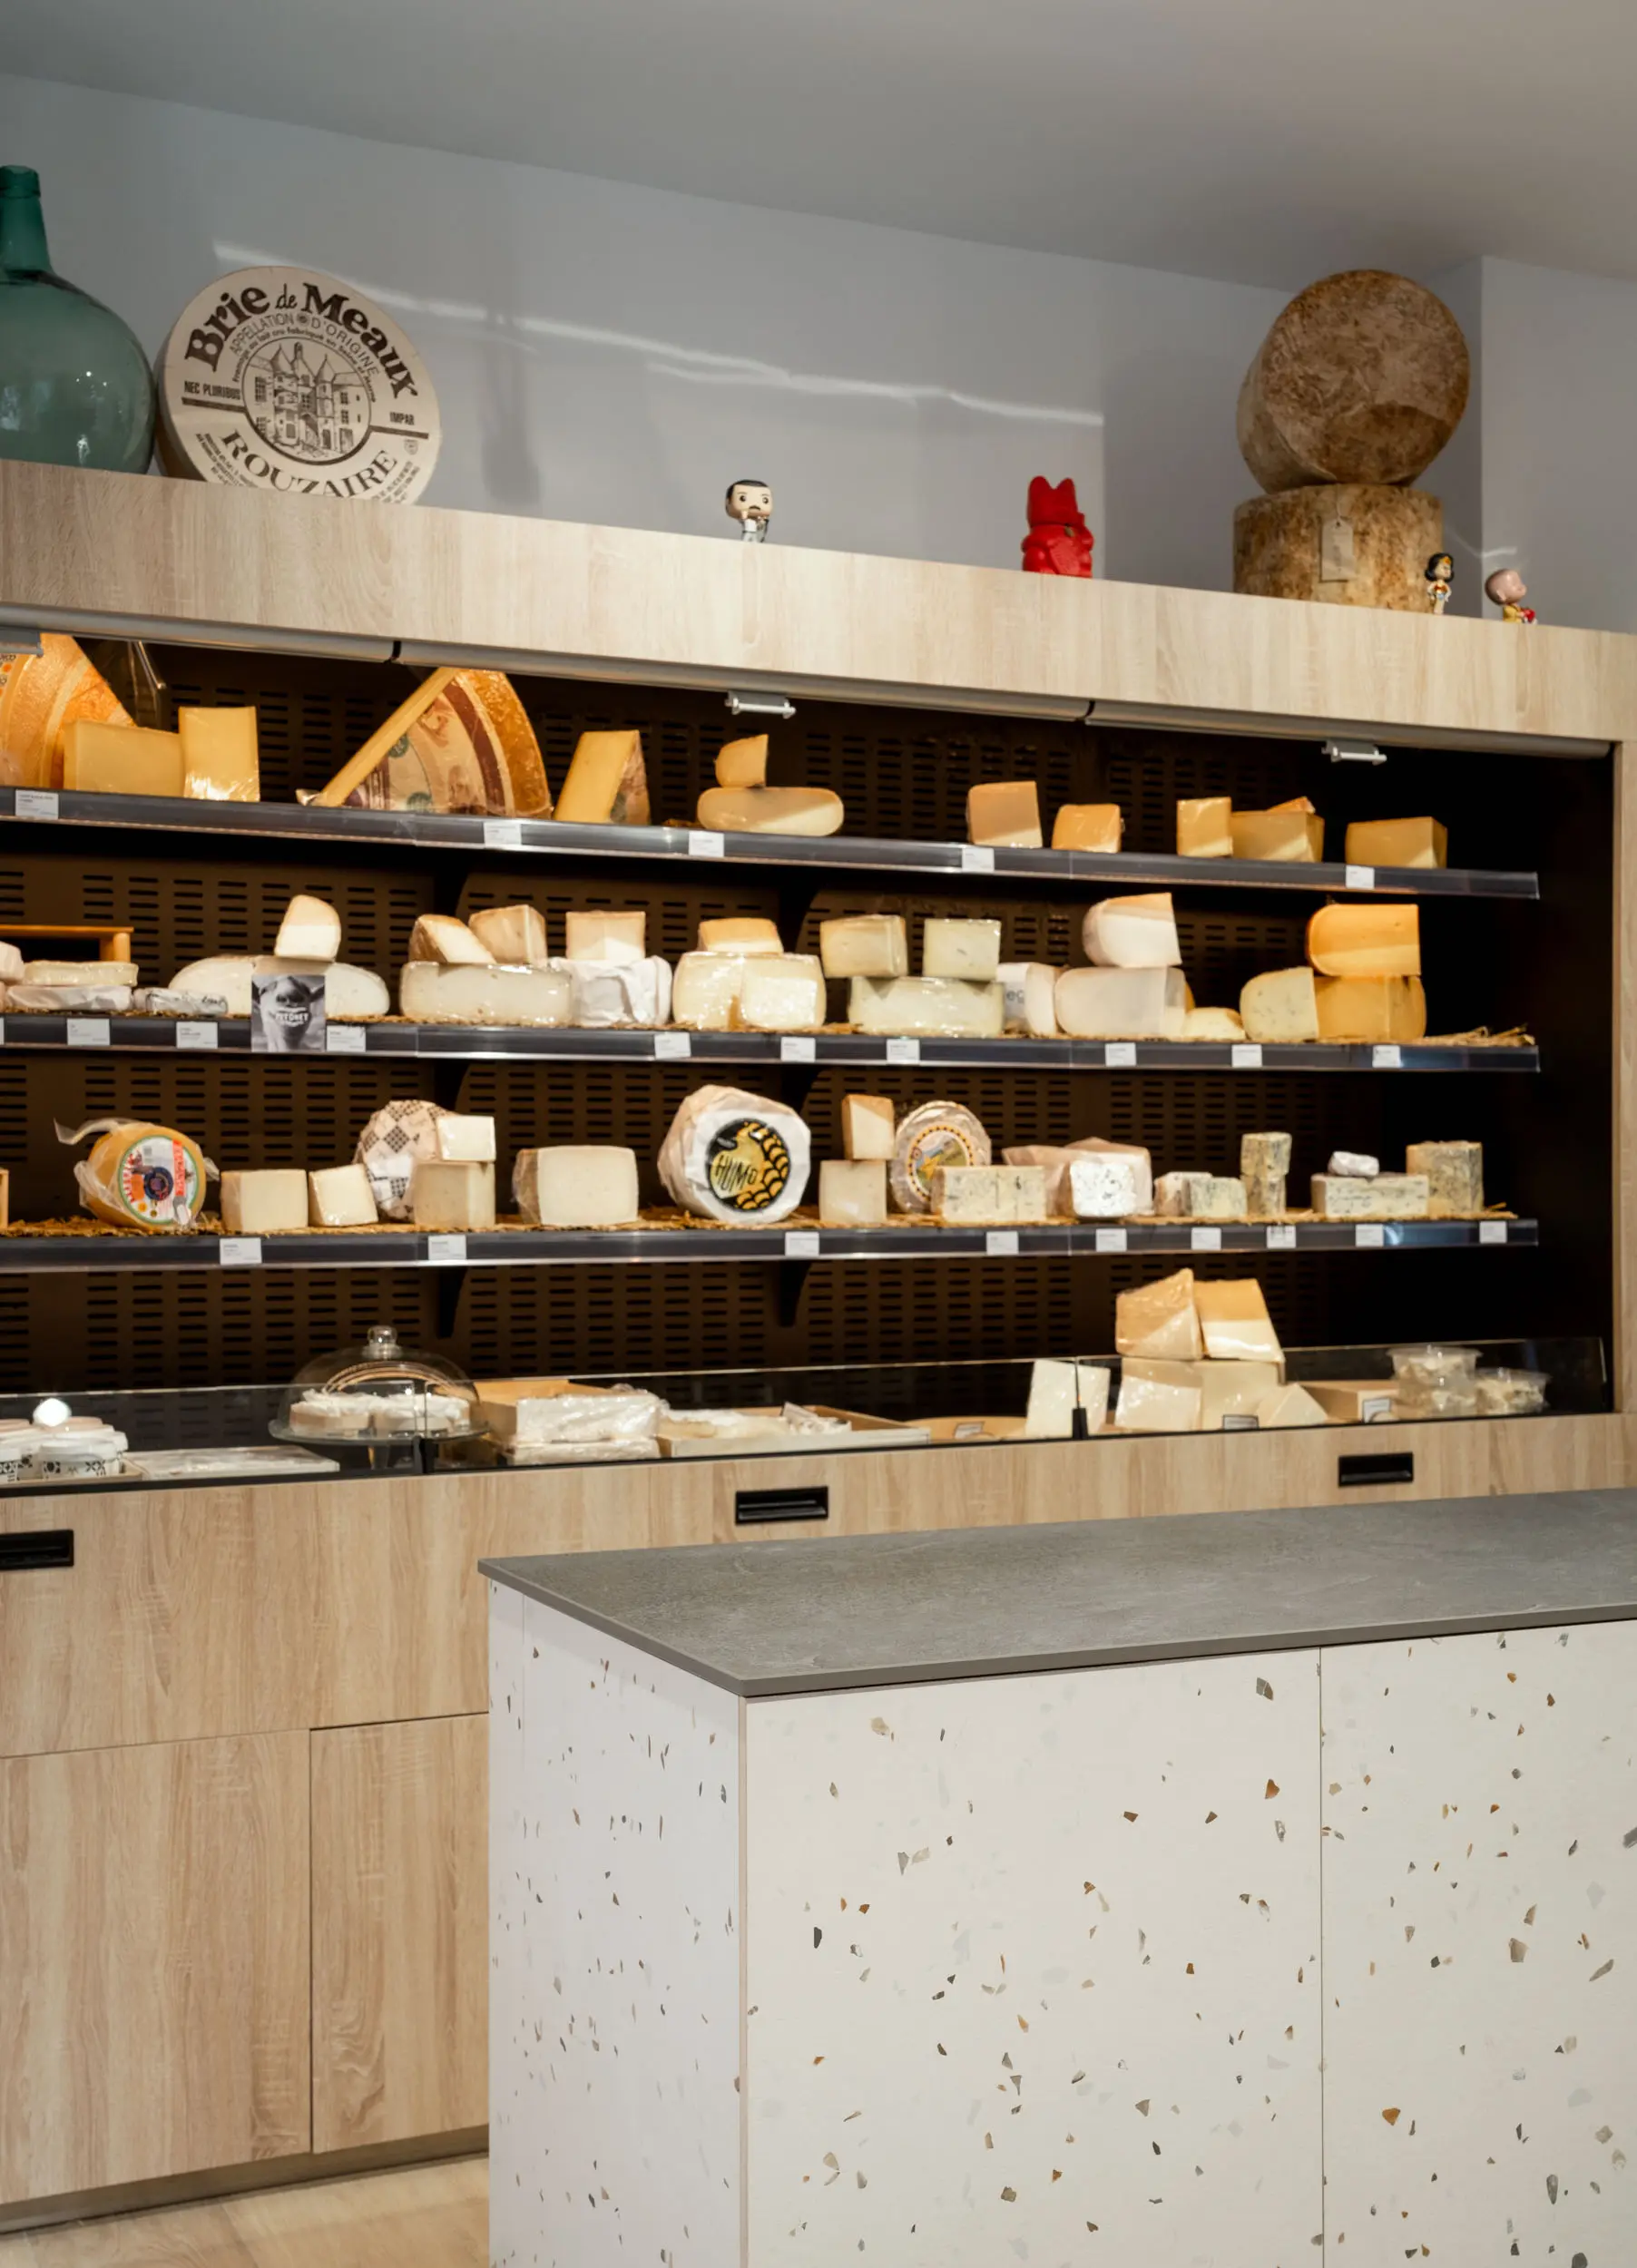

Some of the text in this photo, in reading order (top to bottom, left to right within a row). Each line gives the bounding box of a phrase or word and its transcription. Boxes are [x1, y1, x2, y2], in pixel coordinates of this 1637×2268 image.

[184, 282, 418, 398] Brie de Meaux
[230, 312, 379, 376] APPELLATION D'ORIGINE
[389, 411, 415, 425] IMPAR
[219, 428, 397, 499] ROUZAIRE
